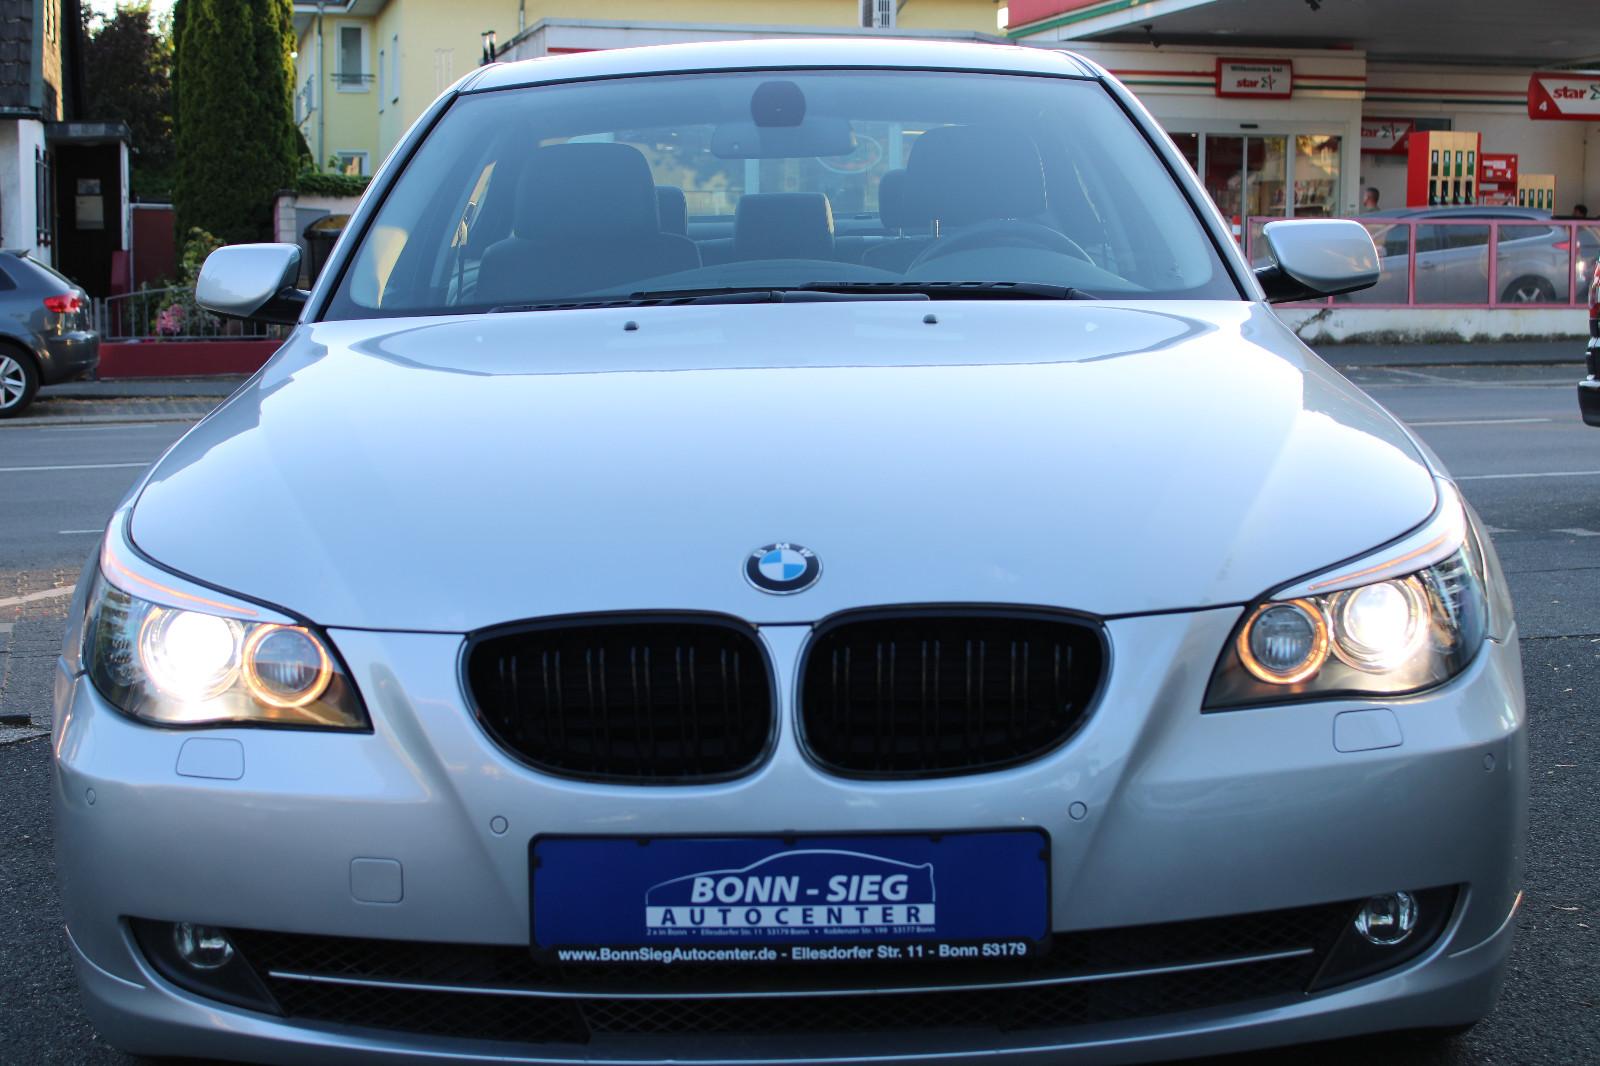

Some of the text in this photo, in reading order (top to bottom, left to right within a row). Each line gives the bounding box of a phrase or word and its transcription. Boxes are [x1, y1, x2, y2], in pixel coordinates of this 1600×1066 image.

[1236, 78, 1259, 88] star
[1553, 86, 1587, 99] star
[1539, 101, 1548, 112] 4
[1361, 127, 1380, 138] tar
[753, 543, 815, 557] BMW
[691, 876, 800, 903] BONN
[826, 874, 909, 902] SIEG
[661, 906, 921, 926] AUTOCENTER
[646, 928, 652, 936] 2
[667, 928, 688, 936] Bonn
[754, 927, 762, 935] 11
[767, 927, 789, 935] 53179
[790, 927, 810, 935] Bonn
[916, 926, 936, 934] Bonn
[558, 947, 777, 963] www.BonnSiegAutocenter.de
[791, 946, 873, 960] Ellesdorfer
[877, 945, 903, 959] Str.
[906, 944, 923, 957] 11
[938, 944, 978, 957] Bonn
[982, 943, 1027, 956] 53179
